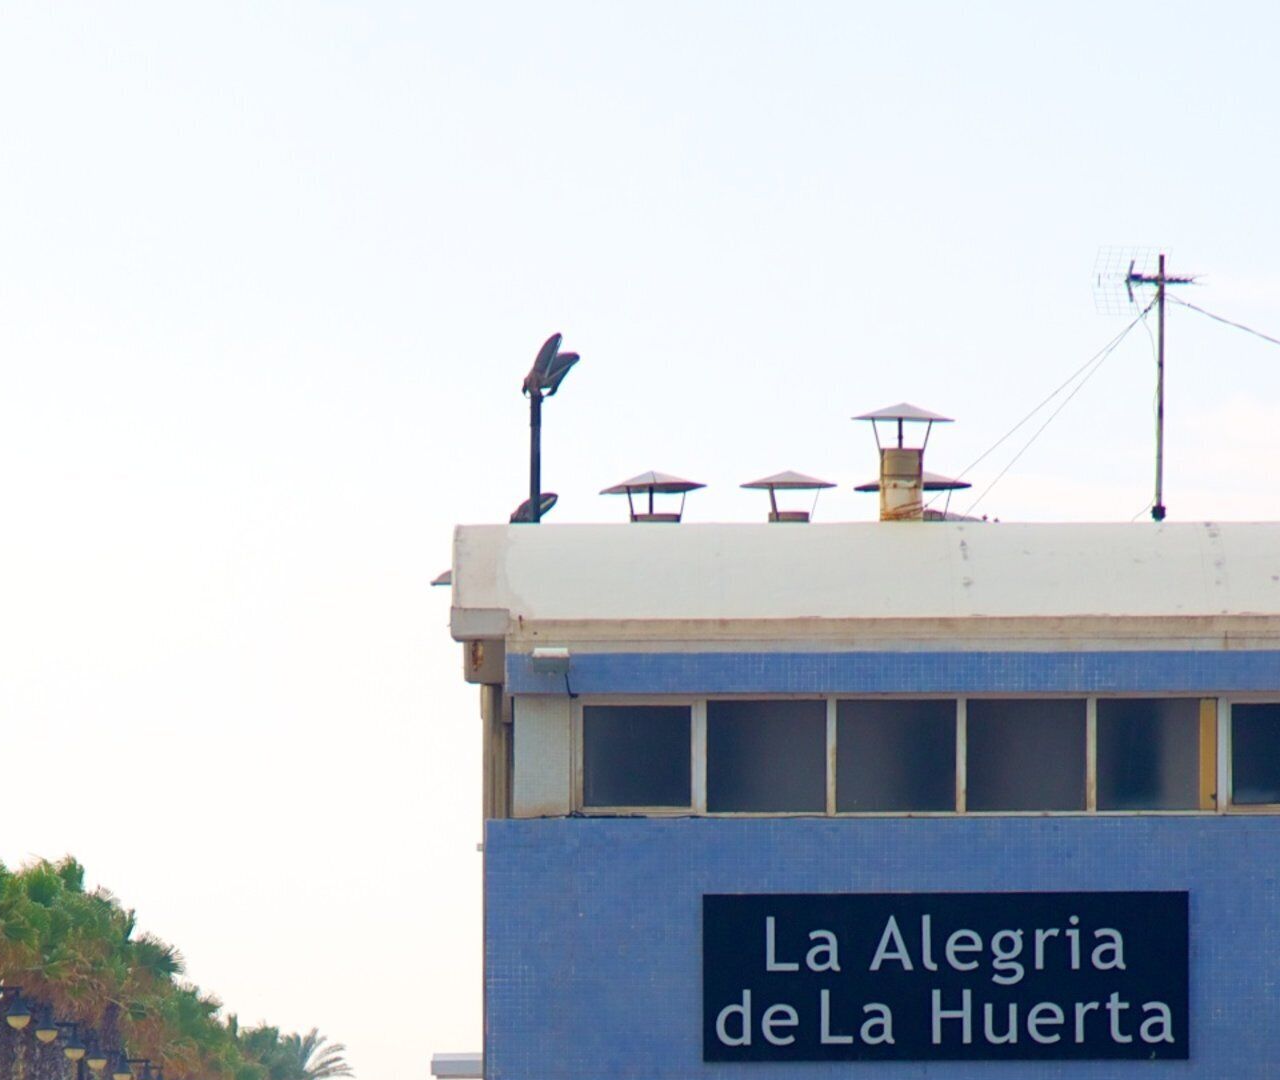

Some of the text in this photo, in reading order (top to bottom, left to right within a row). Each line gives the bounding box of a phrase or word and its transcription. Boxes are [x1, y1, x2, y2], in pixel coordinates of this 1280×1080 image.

[766, 914, 1126, 985] La Alegria
[716, 989, 1174, 1046] de La Huerta
